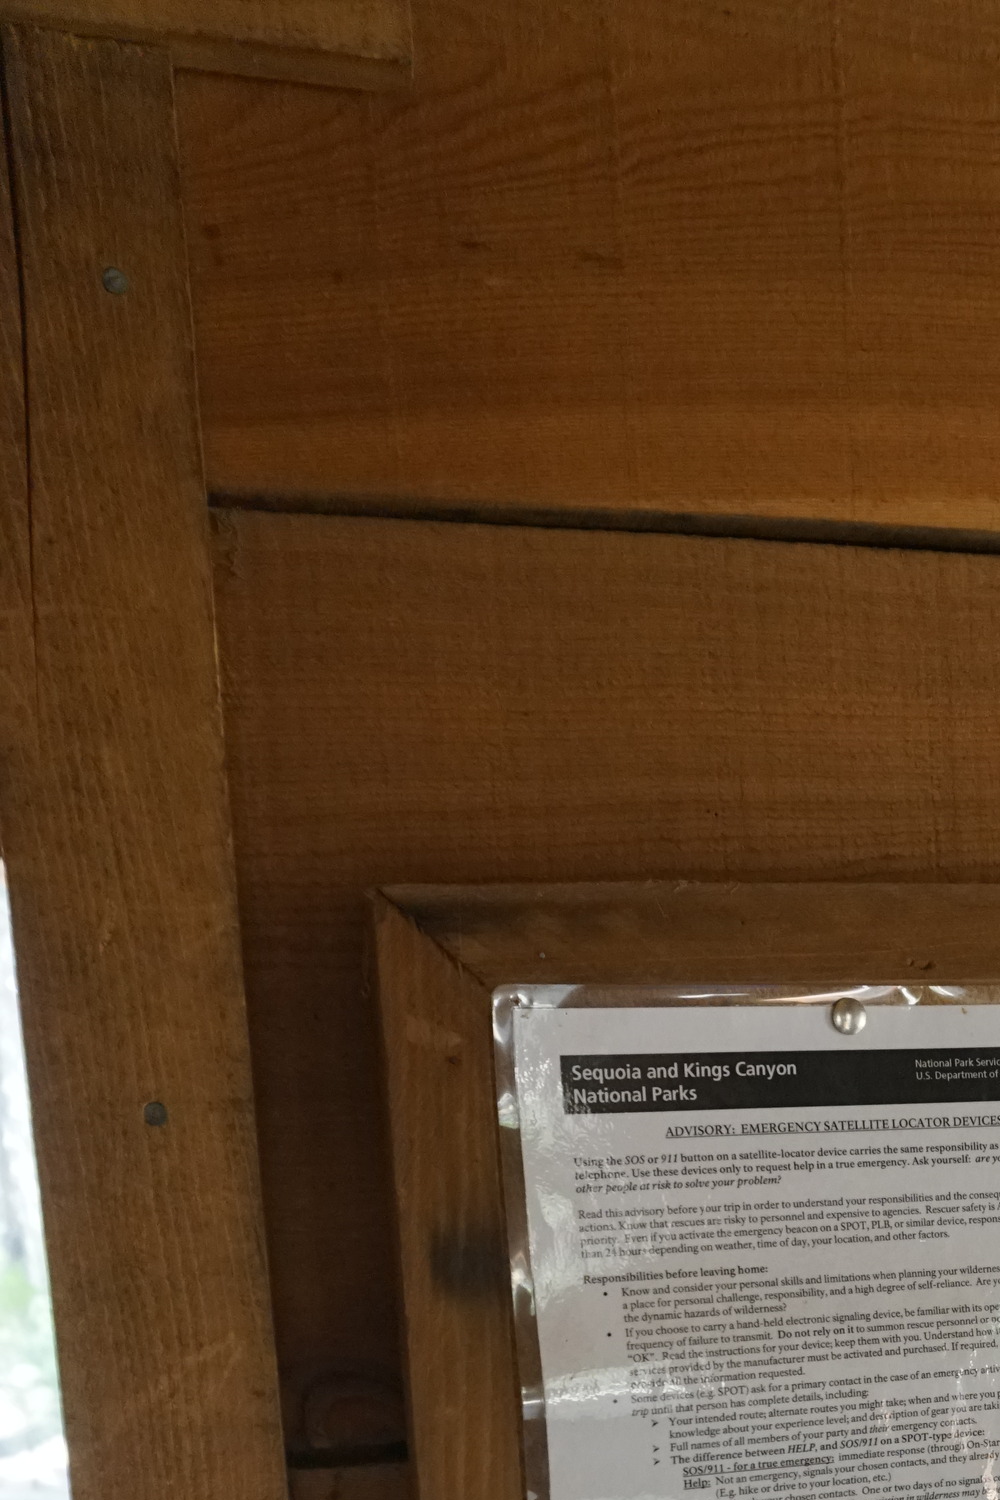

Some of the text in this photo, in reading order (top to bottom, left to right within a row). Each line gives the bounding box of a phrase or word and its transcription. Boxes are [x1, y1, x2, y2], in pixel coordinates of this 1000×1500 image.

[571, 1060, 798, 1084] Sequoia and Kings Canyon
[915, 1058, 952, 1068] National
[954, 1057, 974, 1068] Park
[915, 1070, 932, 1080] U.S.
[934, 1070, 987, 1082] Department
[988, 1068, 998, 1079] of
[573, 1085, 698, 1104] National Parks
[665, 1123, 735, 1139] ADVISORY:
[740, 1120, 820, 1137] EMERGENCY
[823, 1118, 889, 1134] SATELLITE
[891, 1116, 950, 1132] LOCATOR
[583, 1264, 769, 1285] Responsibilities before leaving home:
